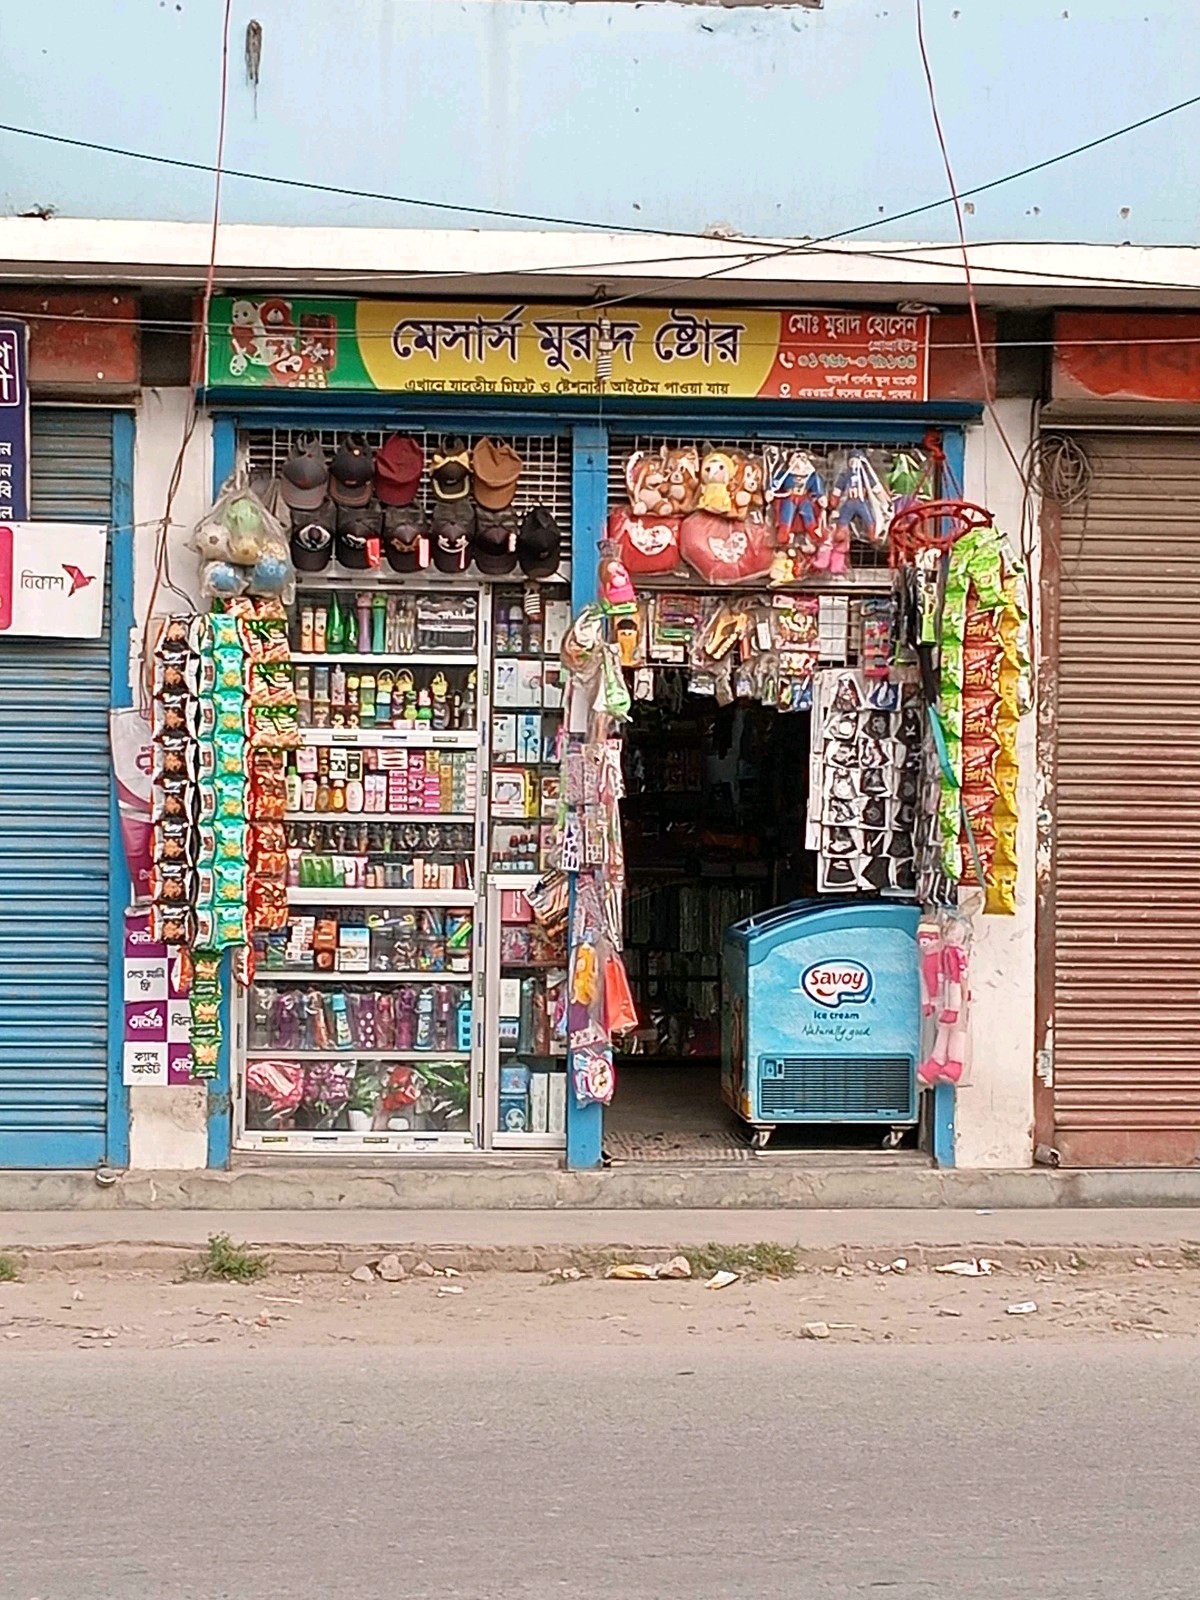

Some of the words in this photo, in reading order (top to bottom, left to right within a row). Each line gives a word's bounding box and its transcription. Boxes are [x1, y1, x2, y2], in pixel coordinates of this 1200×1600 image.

[789, 313, 819, 334] মোঃ
[824, 315, 861, 339] মুরাদ
[867, 316, 918, 336] হোসেন
[394, 304, 527, 362] মেসার্স
[533, 316, 641, 373] মুরাদ
[405, 379, 446, 392] এখানে
[540, 381, 550, 394] ও
[610, 377, 660, 395] আইটেম
[664, 382, 702, 395] পাওয়া
[706, 382, 730, 395] যায়
[21, 569, 64, 590] বিকাশ
[810, 970, 865, 990] Savoy
[814, 1011, 828, 1020] Ice
[830, 1012, 860, 1020] cream
